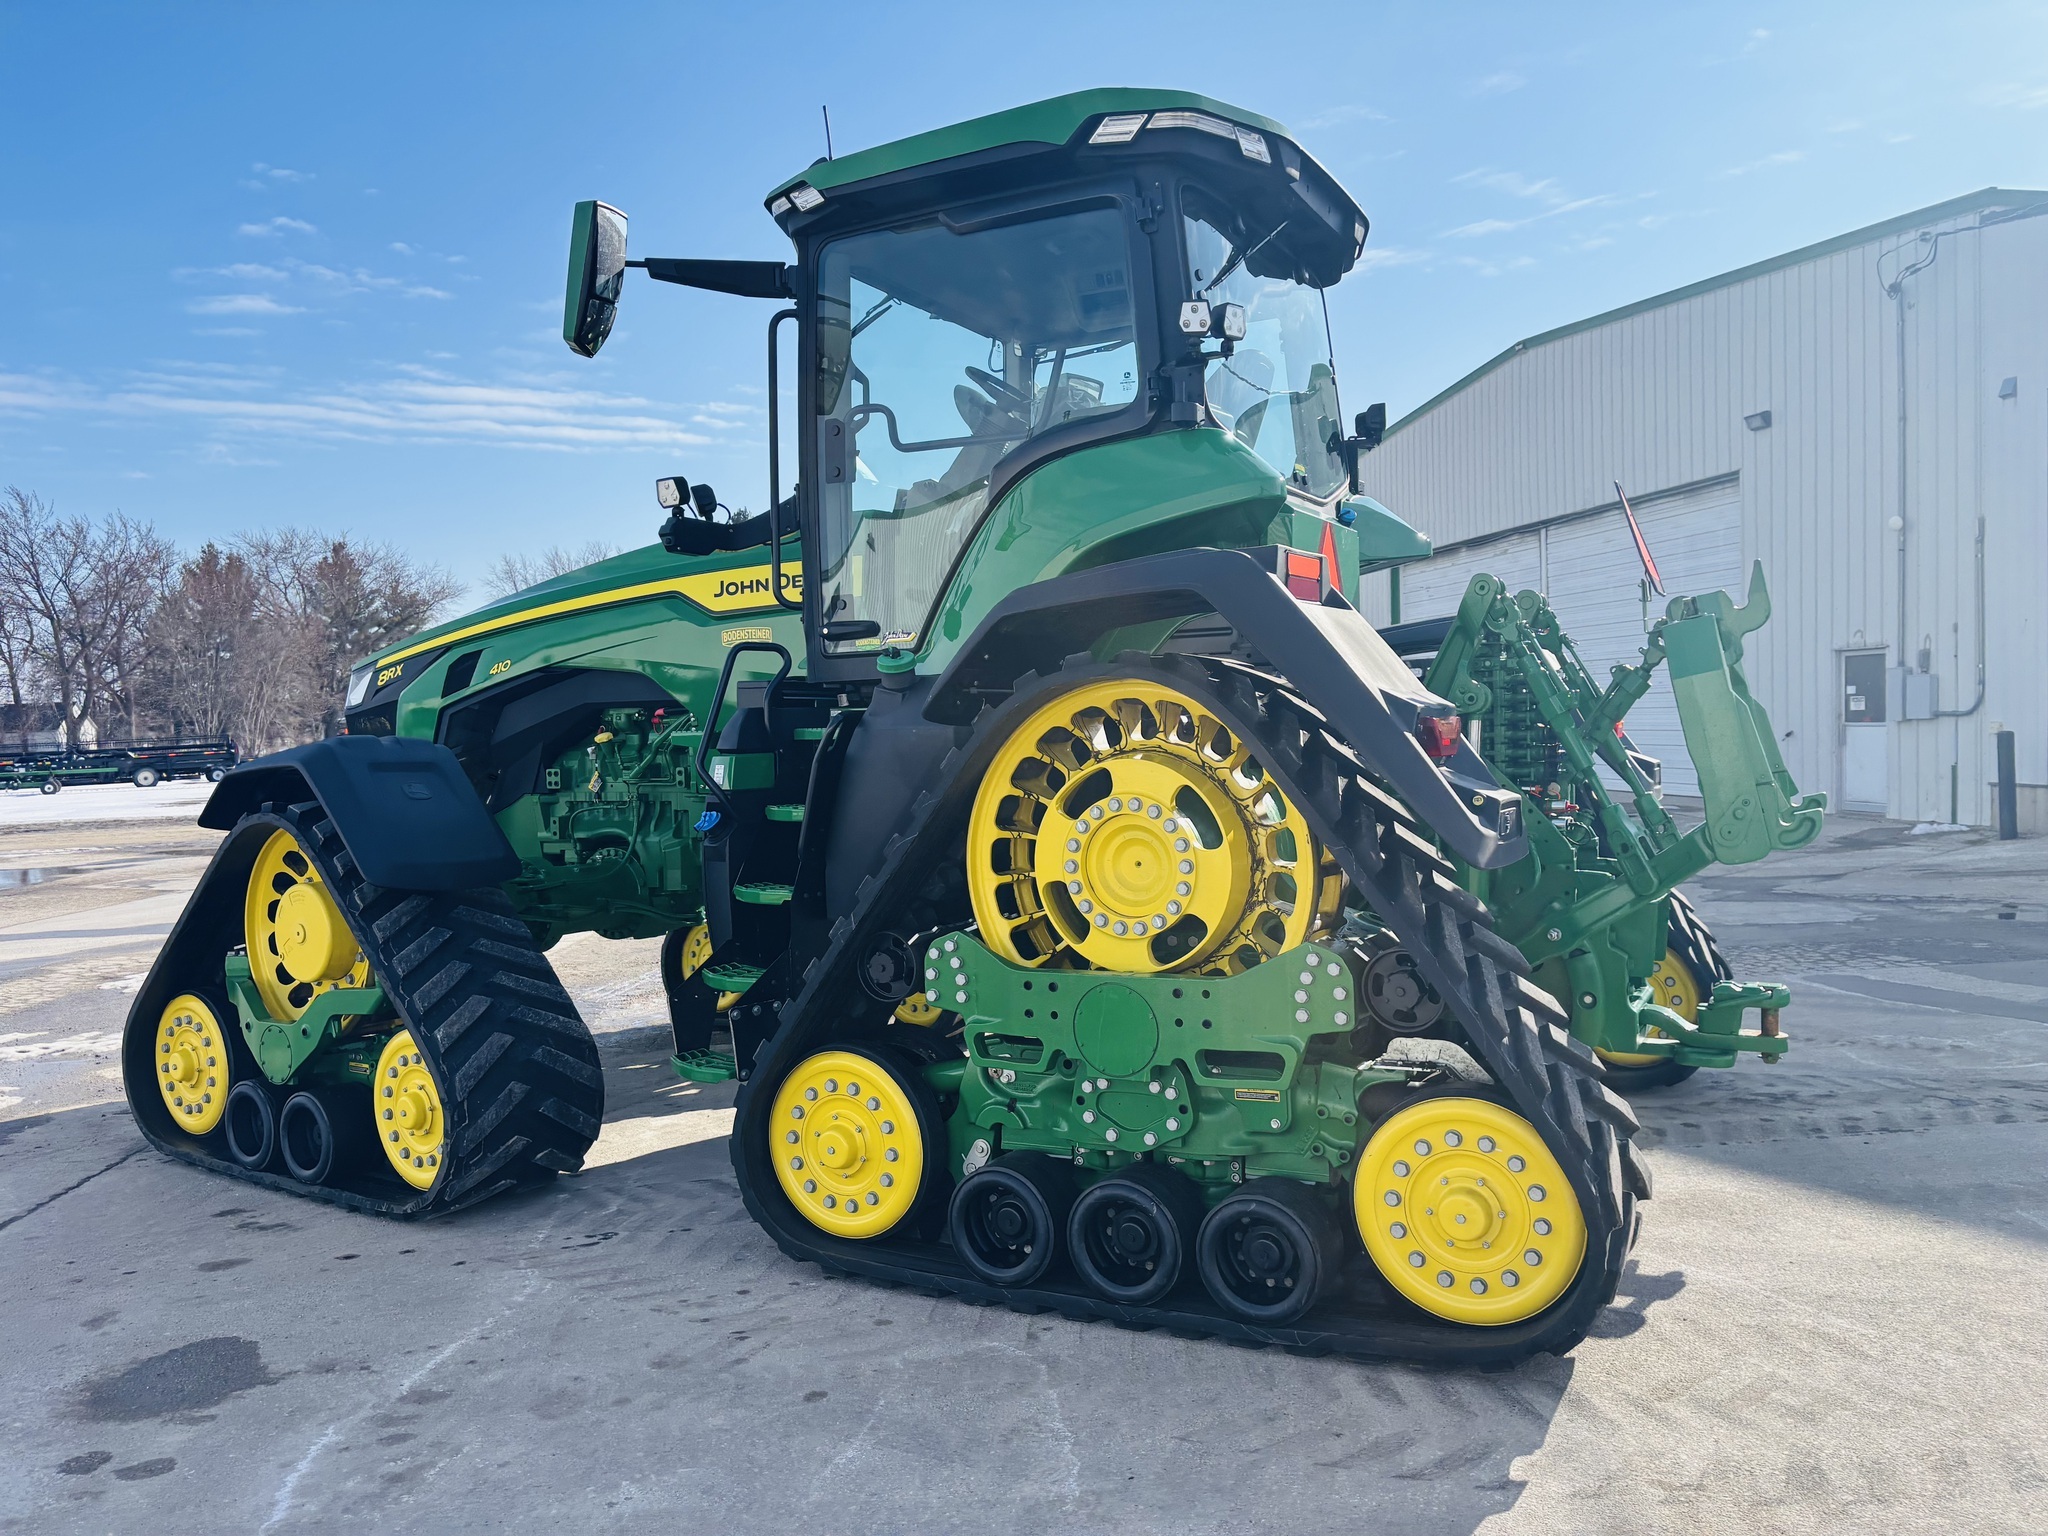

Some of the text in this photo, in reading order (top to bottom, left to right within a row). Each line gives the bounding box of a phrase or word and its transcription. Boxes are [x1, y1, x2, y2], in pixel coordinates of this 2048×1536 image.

[713, 573, 804, 598] JOHN DE
[723, 628, 771, 642] BODENSTEINER
[377, 663, 405, 687] 8RX
[489, 659, 512, 675] 410
